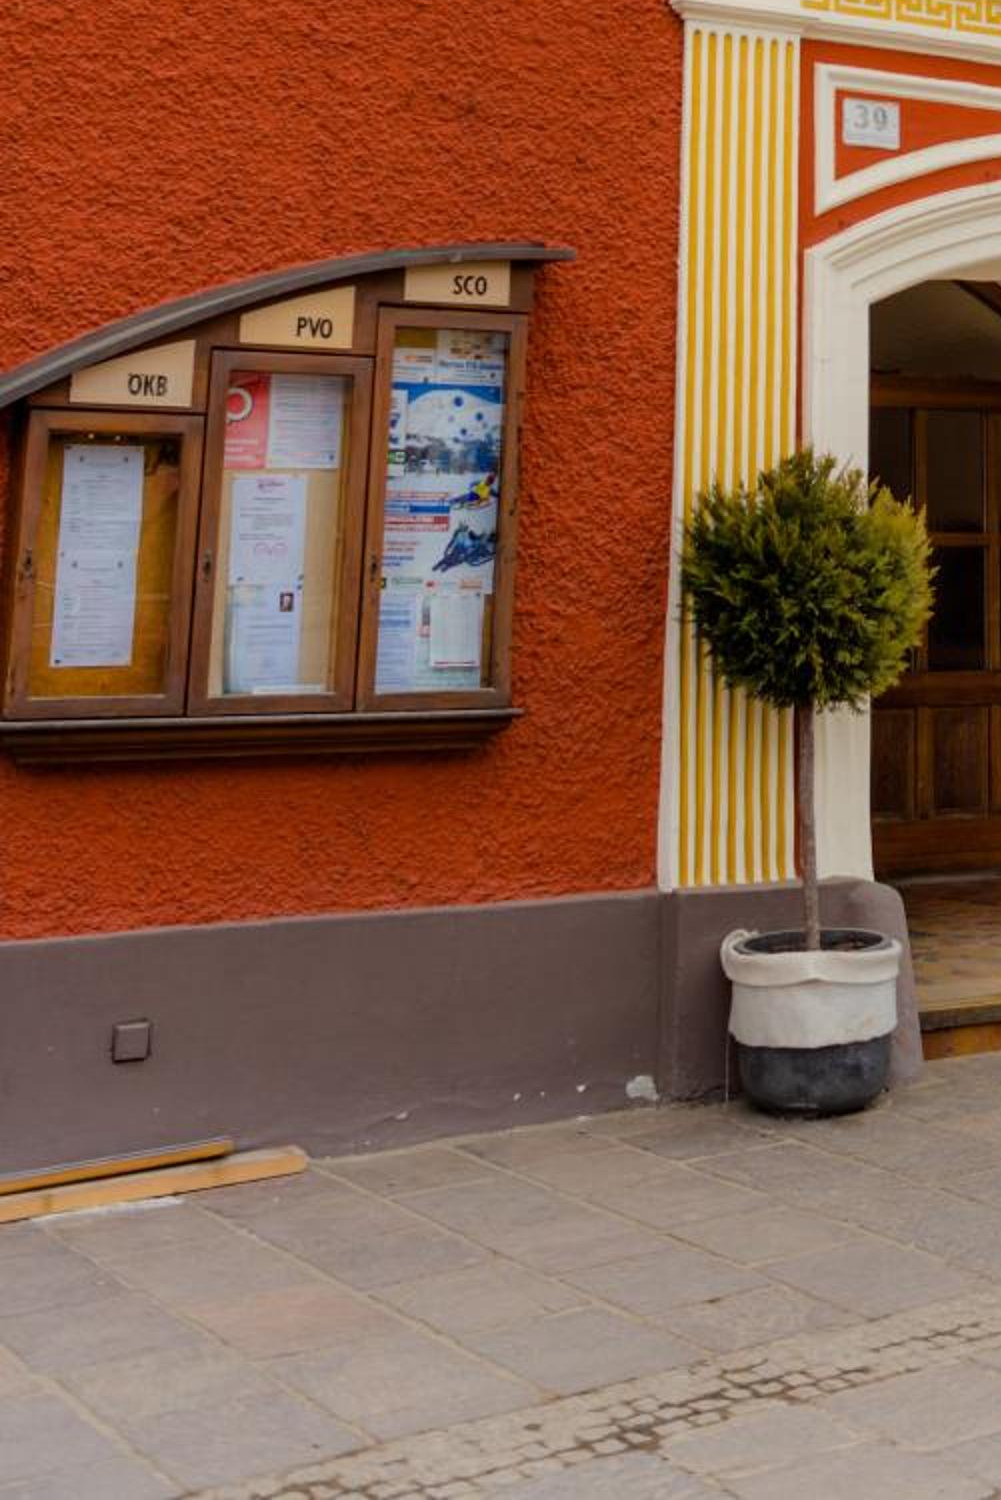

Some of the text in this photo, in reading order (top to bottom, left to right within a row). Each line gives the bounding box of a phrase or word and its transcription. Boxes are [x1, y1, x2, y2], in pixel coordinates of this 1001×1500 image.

[852, 103, 888, 132] 39
[453, 275, 487, 296] SCO
[297, 316, 333, 339] PVO
[127, 372, 168, 396] ÖKB
